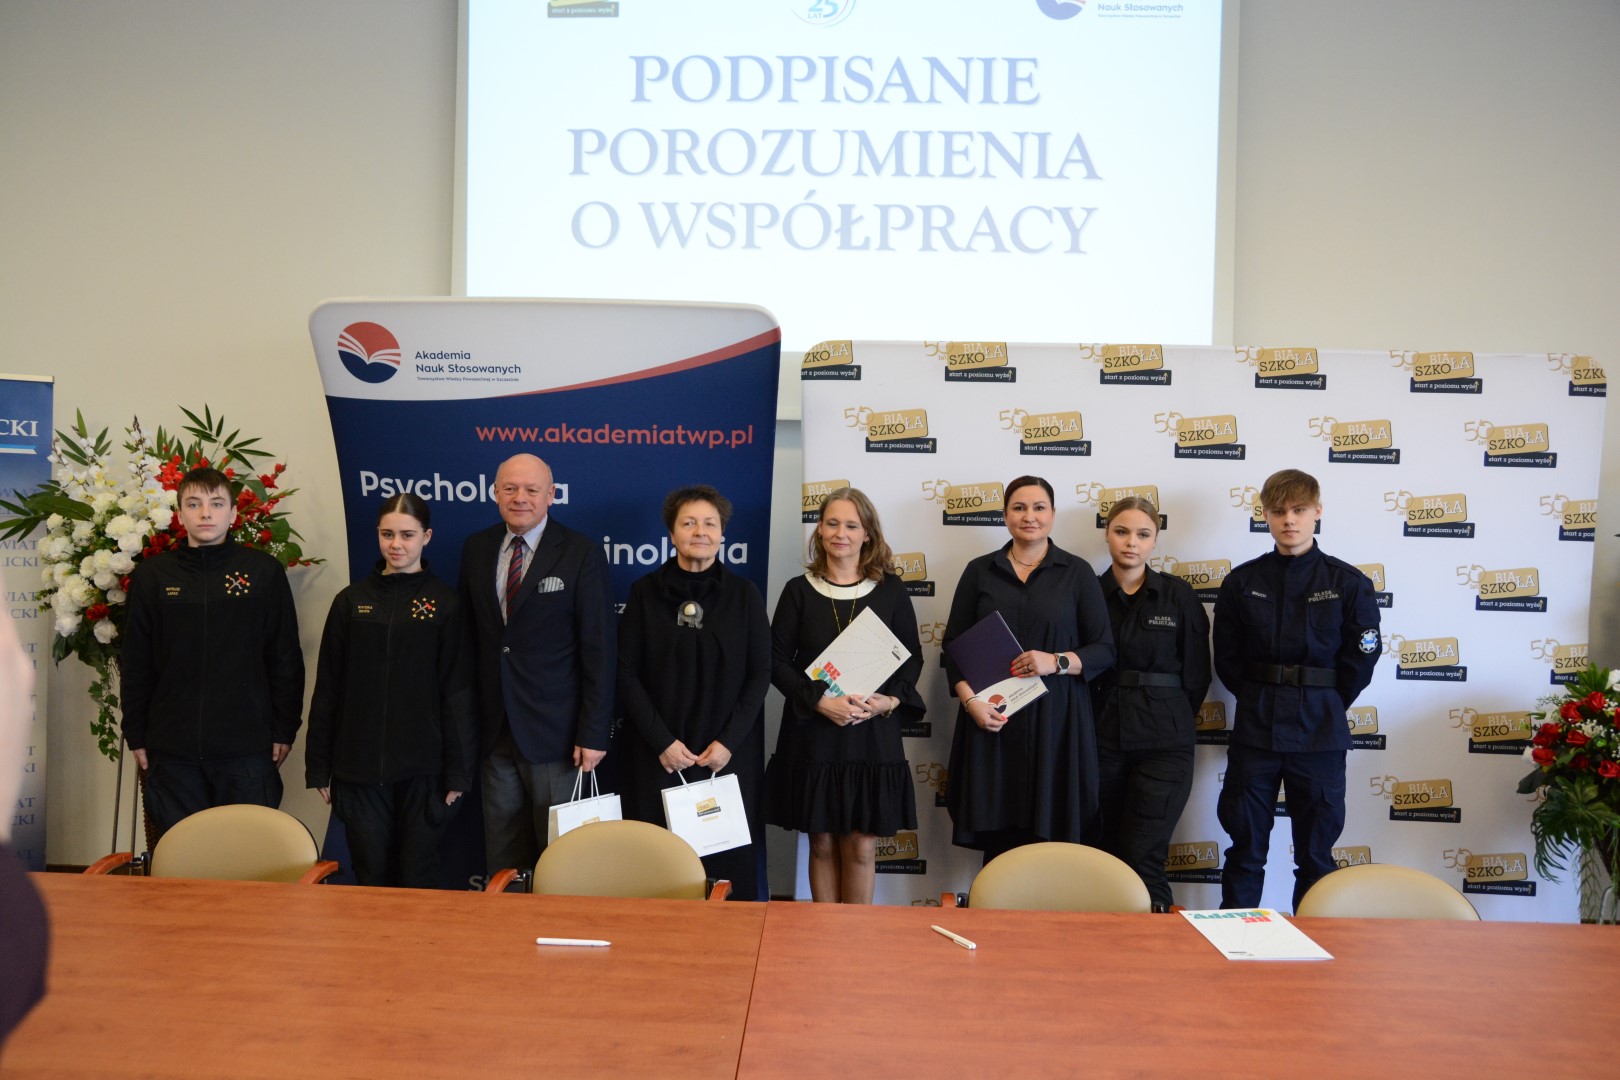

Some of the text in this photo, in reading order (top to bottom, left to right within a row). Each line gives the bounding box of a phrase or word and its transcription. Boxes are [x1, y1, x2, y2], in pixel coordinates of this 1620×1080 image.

[629, 55, 1041, 106] PODPISANIE
[567, 128, 1103, 181] POROZUMIENIA
[570, 189, 1100, 254] O WSPÓŁPRACY
[414, 350, 471, 360] Akademia
[416, 364, 522, 376] Nauk Stosowanych
[475, 422, 753, 449] www.akademiatwp.pl
